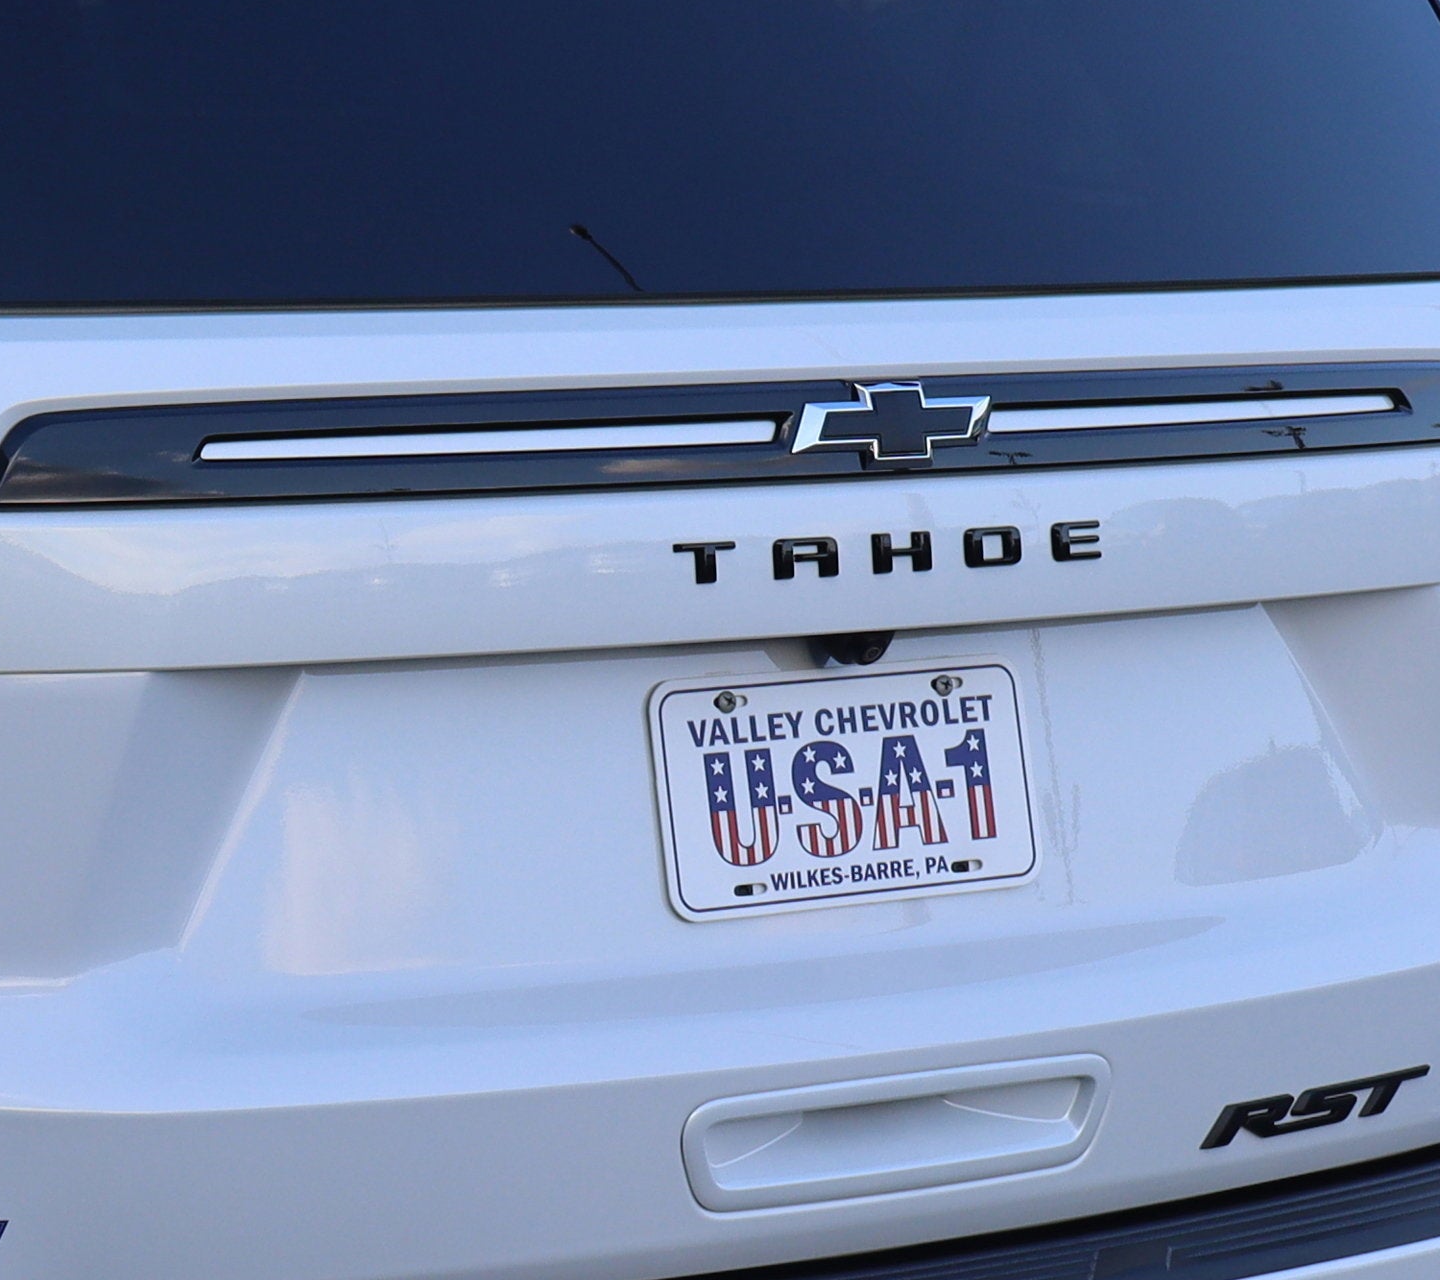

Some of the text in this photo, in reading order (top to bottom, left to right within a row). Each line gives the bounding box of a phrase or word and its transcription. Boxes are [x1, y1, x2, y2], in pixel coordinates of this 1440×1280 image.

[672, 520, 1103, 585] TAHOE
[687, 695, 993, 748] VALLEY CHEVROLET
[770, 857, 949, 892] WILKES-BARRE, PA
[1199, 1063, 1431, 1150] RST
